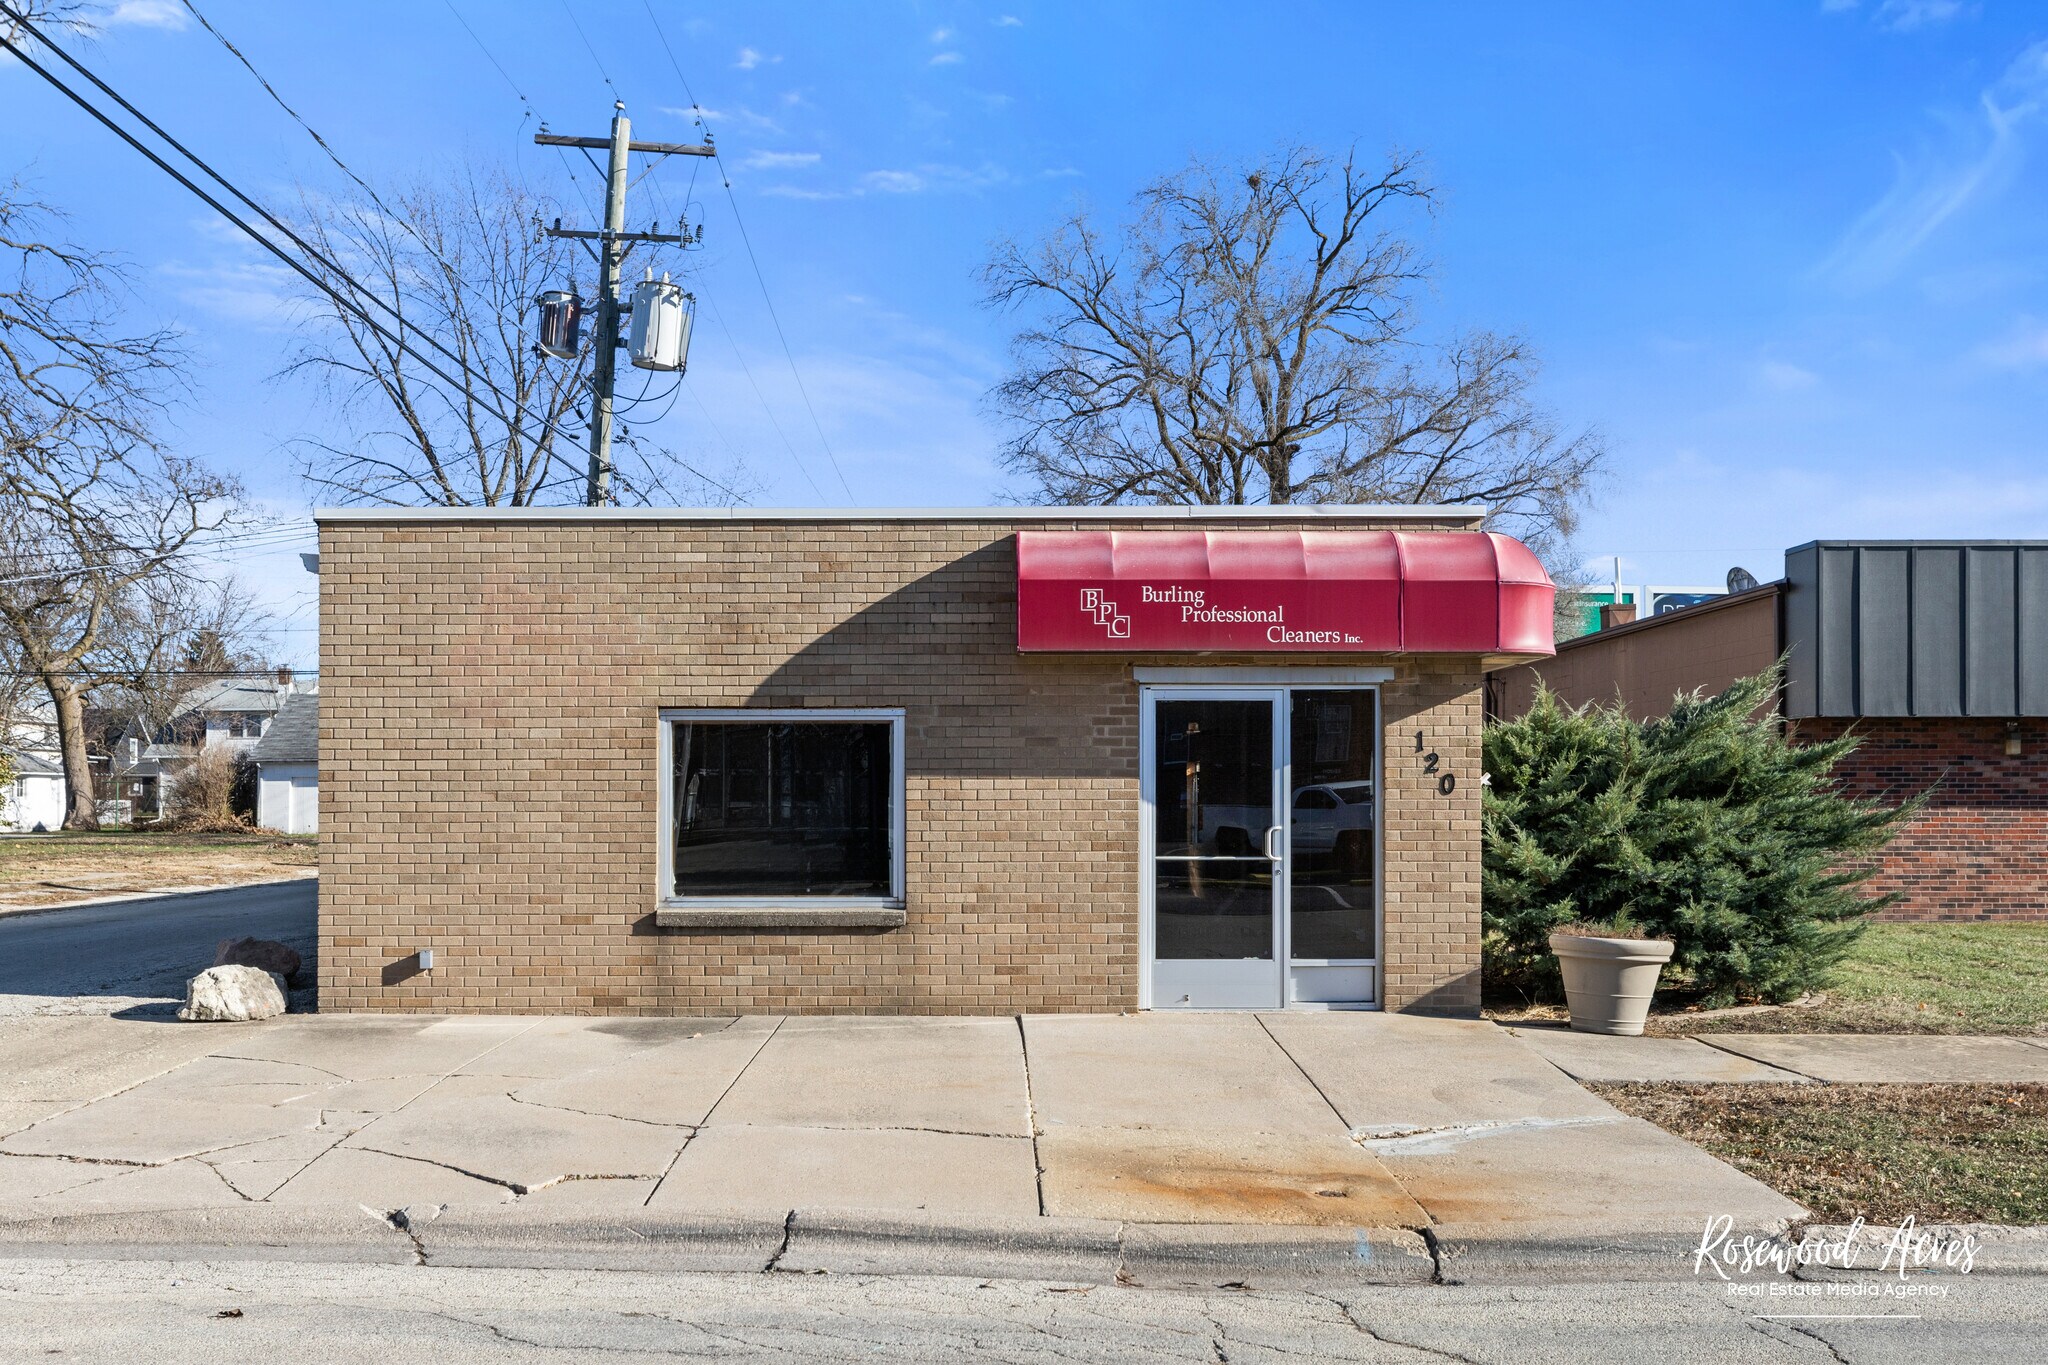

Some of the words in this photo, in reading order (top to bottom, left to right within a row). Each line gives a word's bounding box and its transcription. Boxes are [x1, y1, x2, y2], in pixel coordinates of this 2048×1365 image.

[1141, 585, 1205, 608] Burling
[1181, 604, 1284, 623] Professional
[1266, 625, 1341, 643] Cleaners
[1344, 633, 1364, 644] Inc.
[1414, 730, 1456, 796] 120
